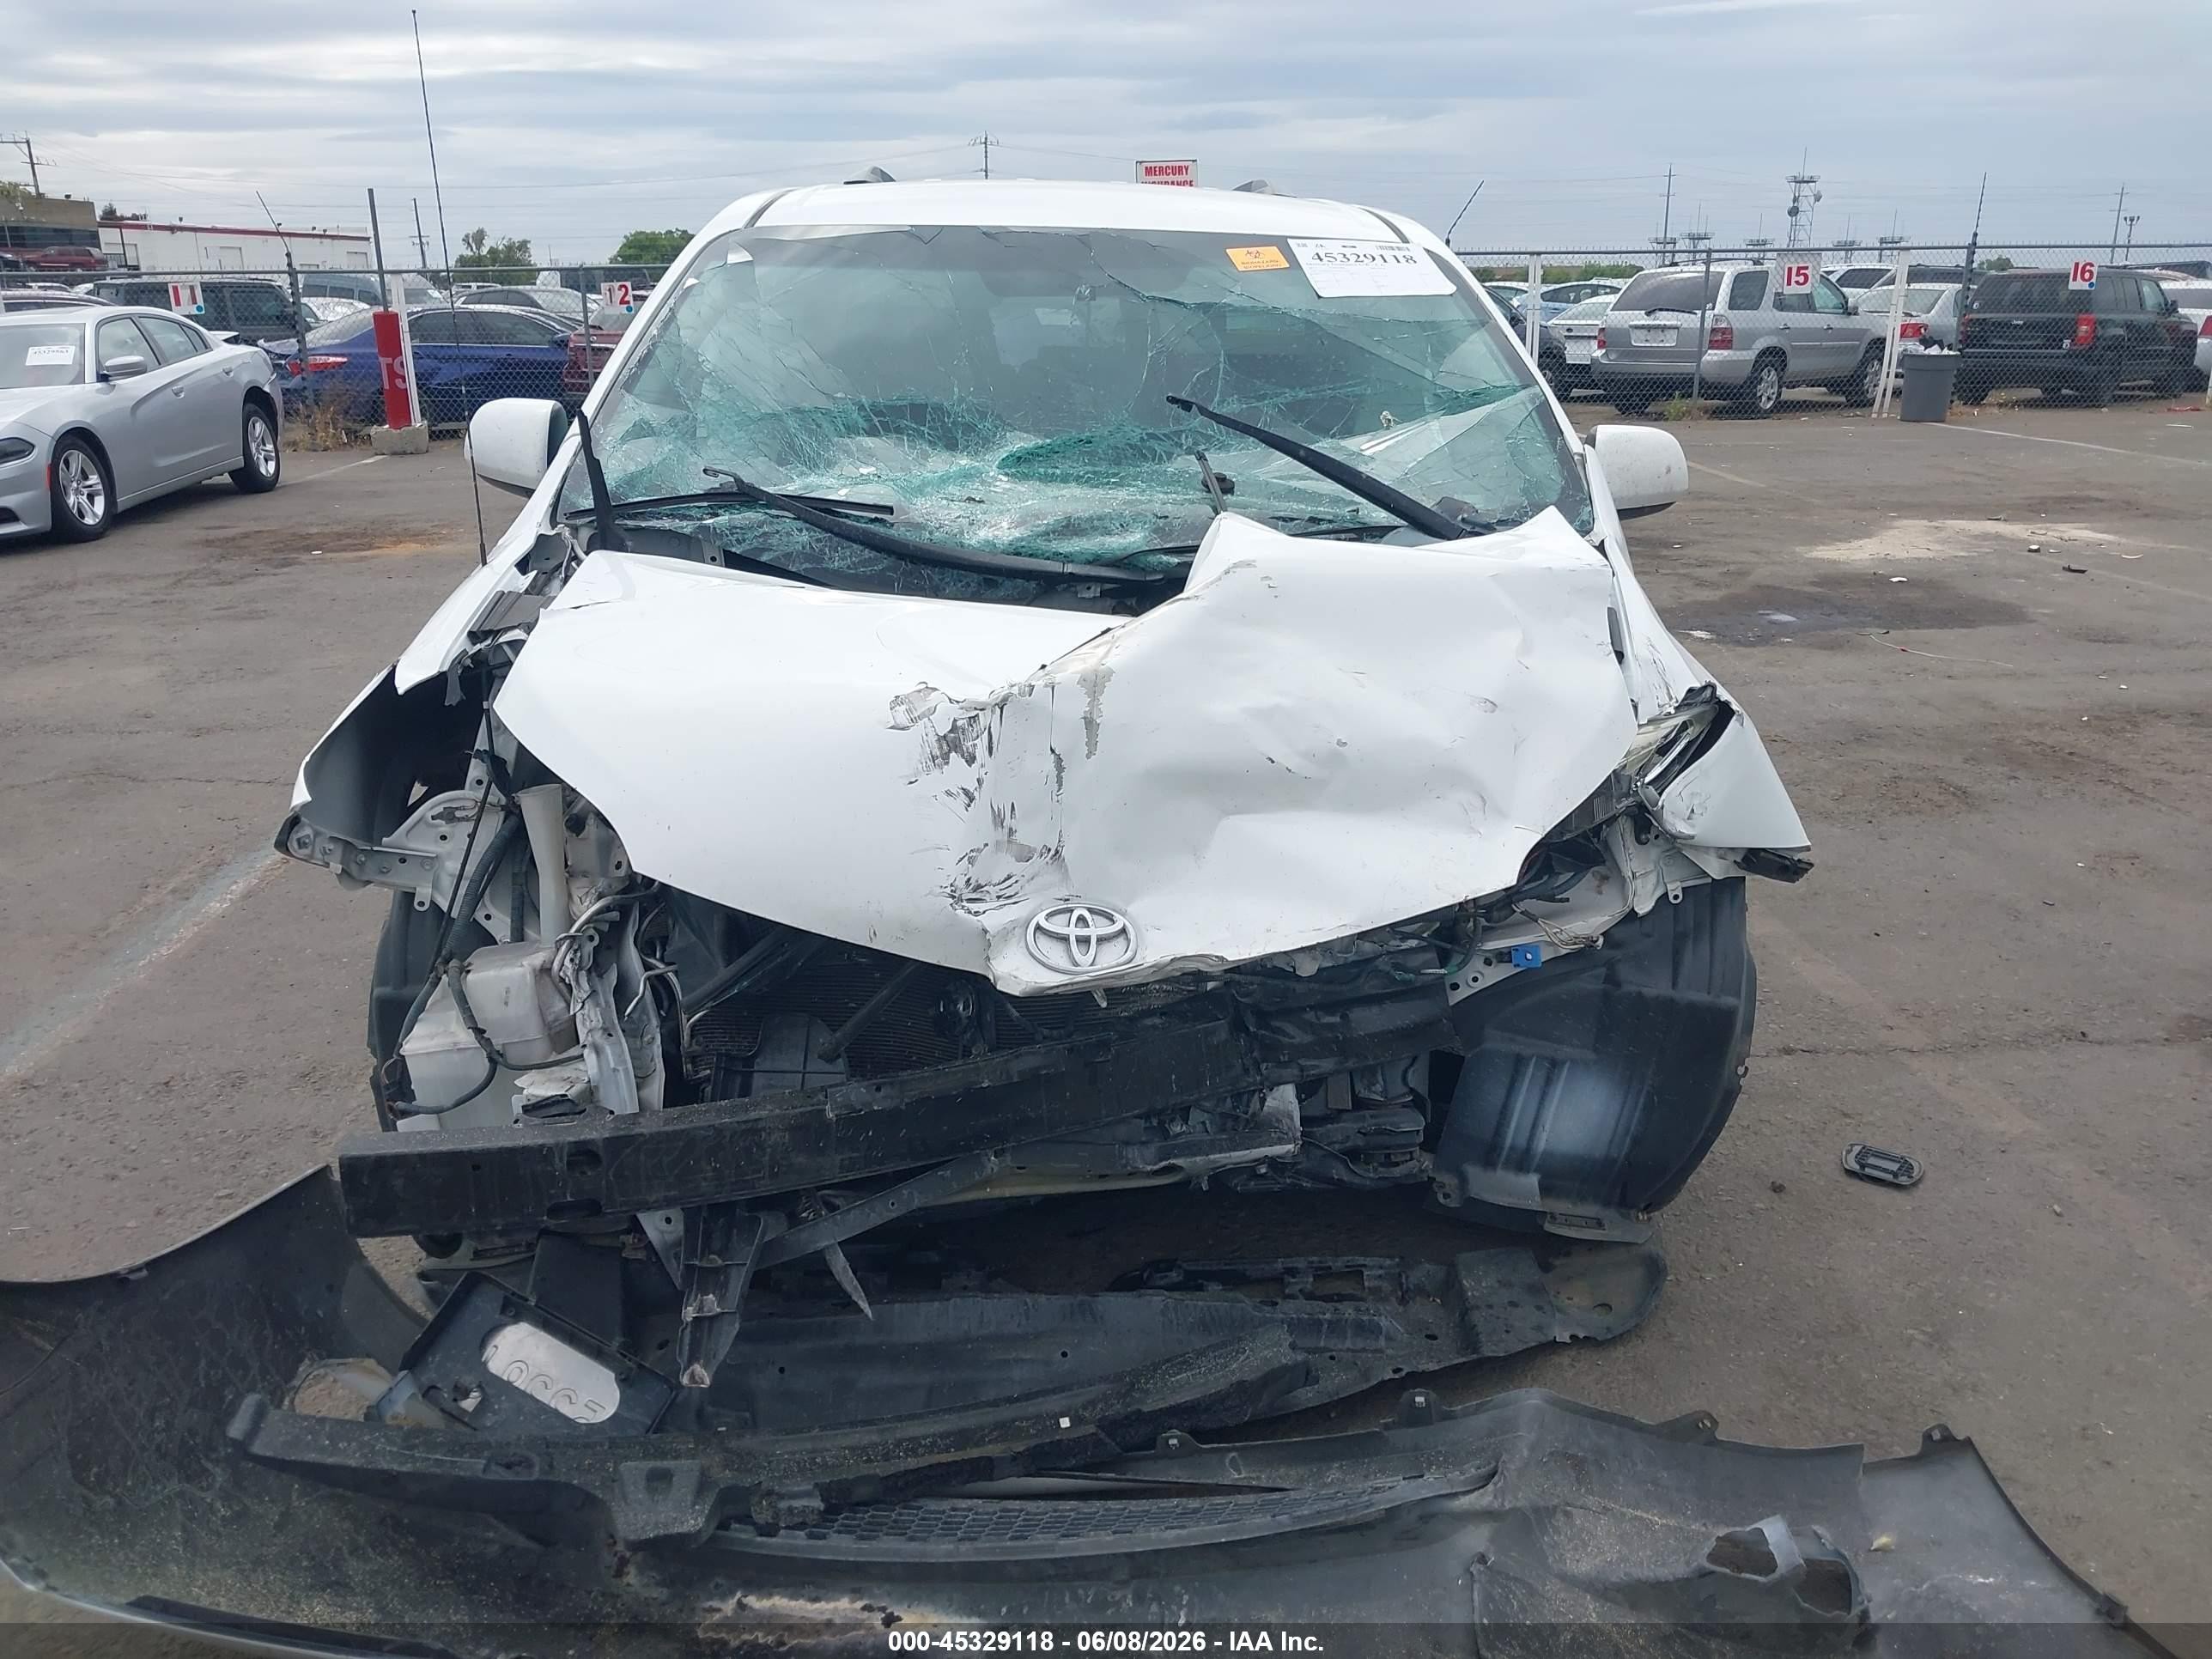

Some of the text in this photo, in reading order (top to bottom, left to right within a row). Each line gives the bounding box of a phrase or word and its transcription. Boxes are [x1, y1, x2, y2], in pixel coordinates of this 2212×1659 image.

[1144, 165, 1189, 177] MERCURY
[1311, 252, 1417, 264] 45329118
[1786, 265, 1809, 287] 15
[2072, 261, 2094, 283] 16
[606, 283, 631, 306] 12
